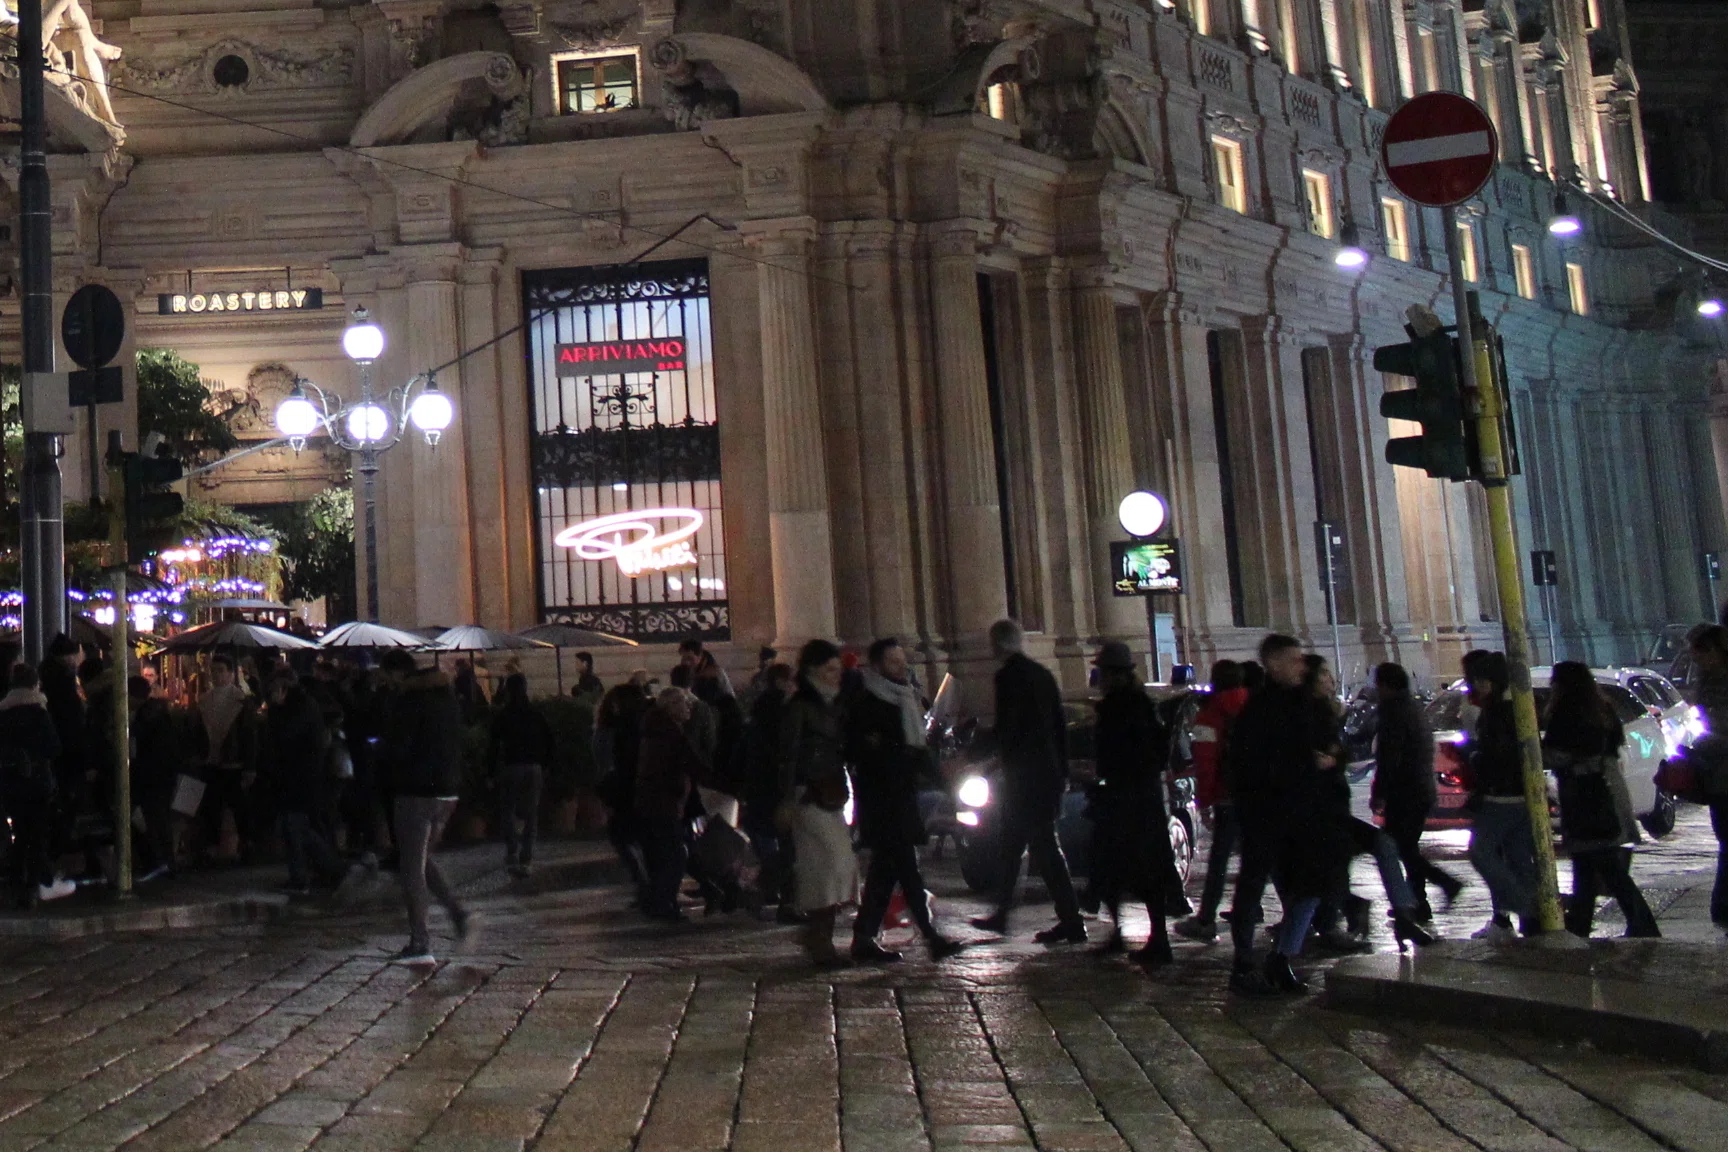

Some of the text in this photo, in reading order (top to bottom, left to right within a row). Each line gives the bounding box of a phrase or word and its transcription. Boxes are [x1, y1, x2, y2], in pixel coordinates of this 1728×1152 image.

[172, 290, 307, 312] ROASTERY
[560, 341, 683, 364] ARRIVIAMO
[658, 359, 684, 371] BAR
